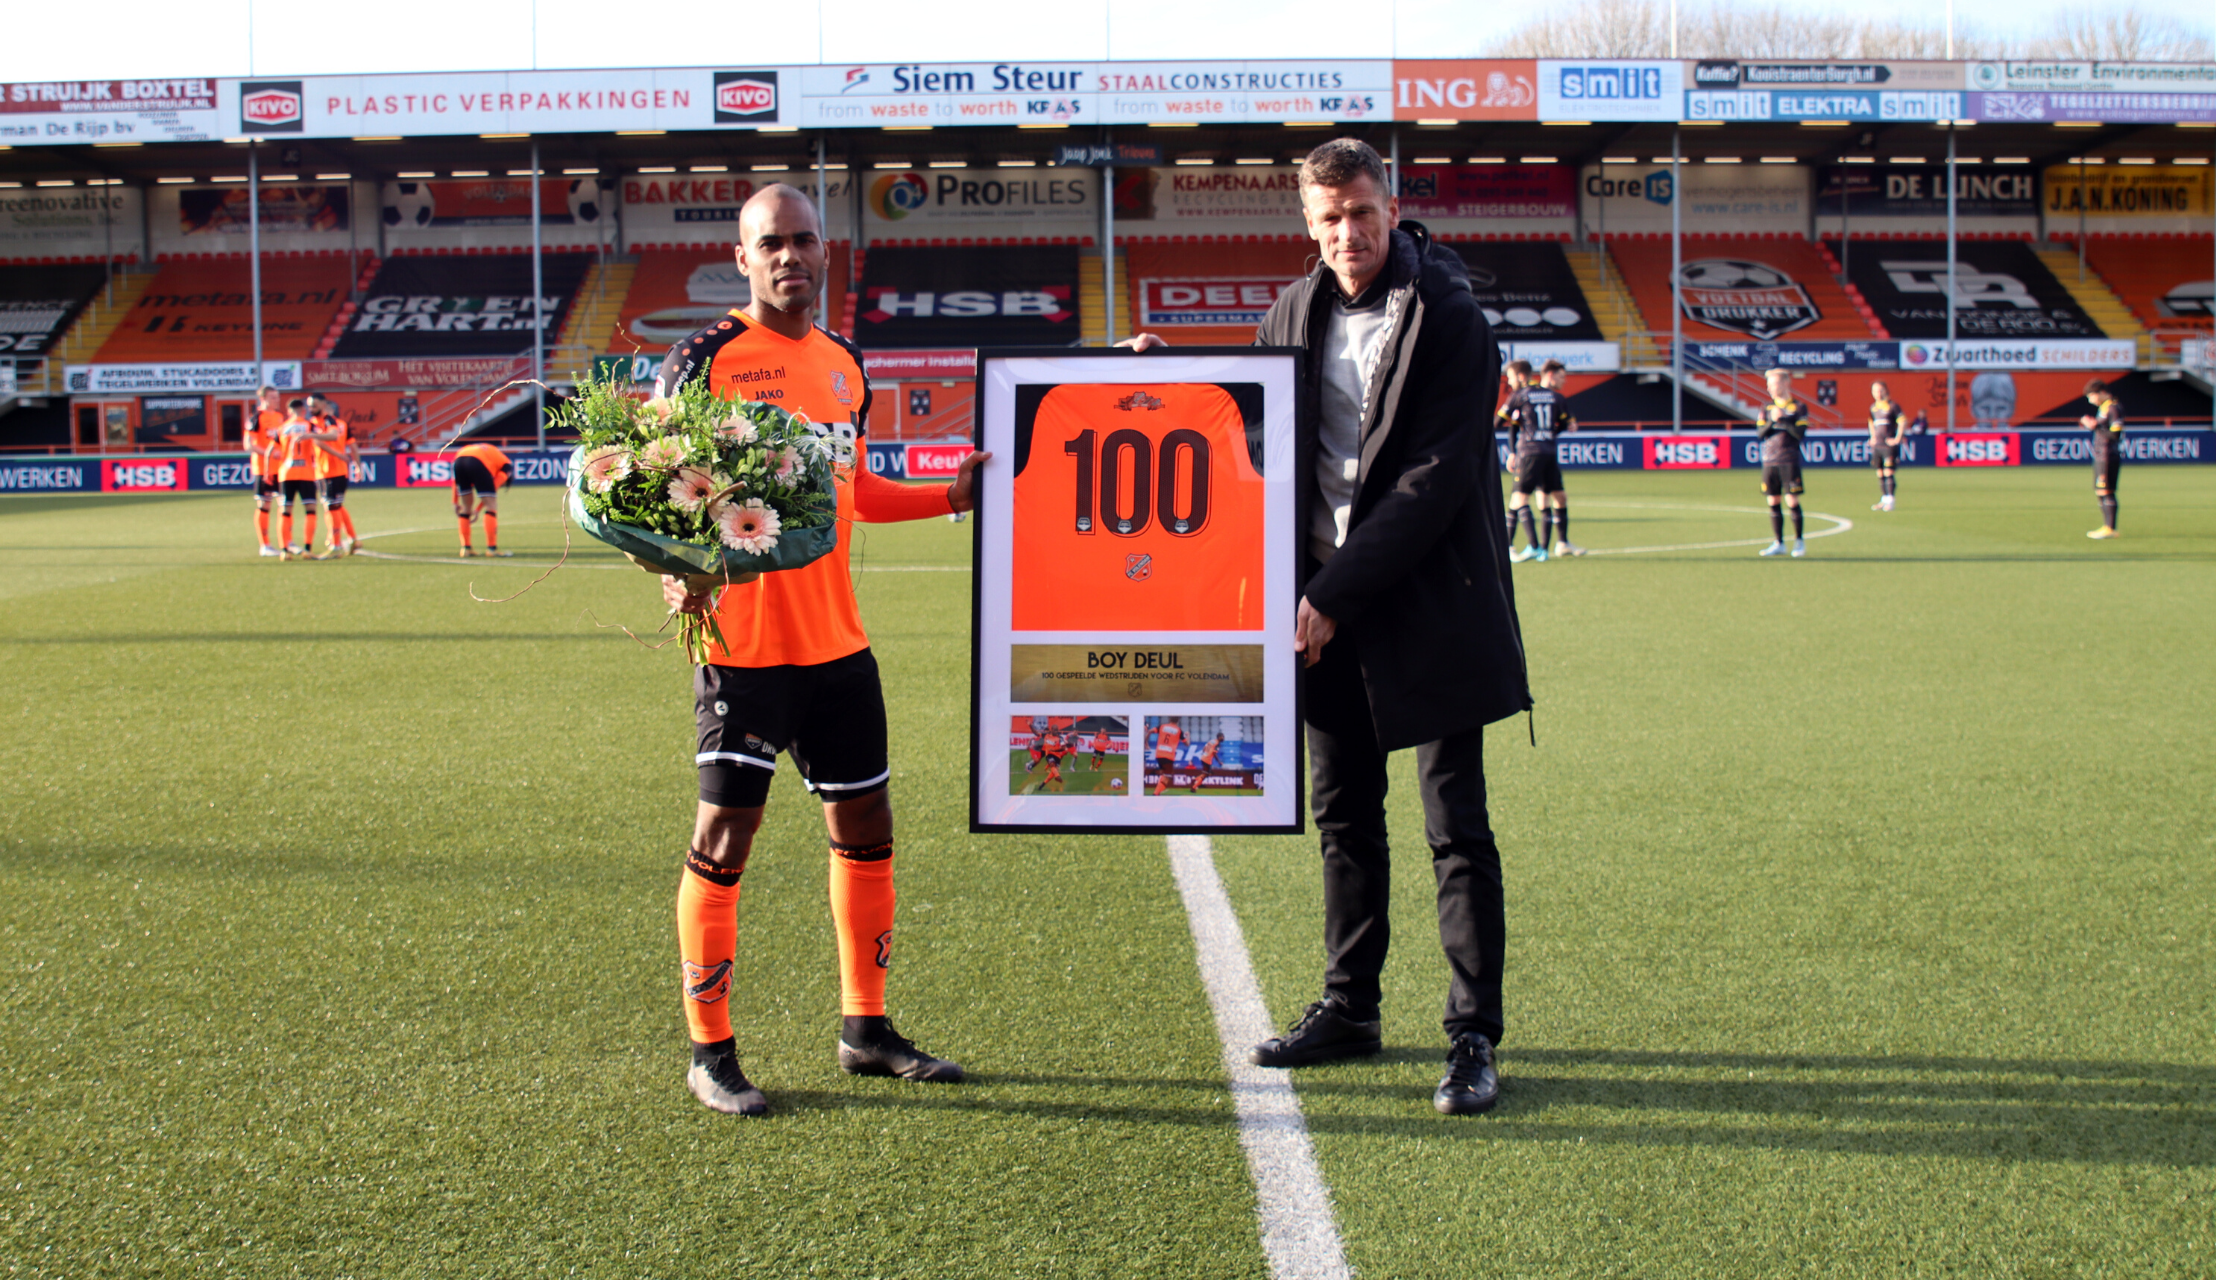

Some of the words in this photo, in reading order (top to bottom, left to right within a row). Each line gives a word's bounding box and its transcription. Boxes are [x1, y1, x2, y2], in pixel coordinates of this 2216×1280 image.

[894, 66, 975, 93] Siem
[993, 65, 1083, 92] Steur
[1696, 66, 1740, 81] Koffie?
[2006, 61, 2080, 79] Leinster
[11, 82, 113, 102] STRUIJK
[121, 80, 215, 101] BOXTEL
[1098, 72, 1343, 91] STAALCONSTRUCTIES
[1562, 68, 1660, 98] smit
[722, 91, 770, 106] KIVO
[1397, 78, 1478, 108] ING
[248, 101, 296, 116] KIVO
[328, 95, 449, 116] PLASTIC
[459, 90, 690, 112] VERPAKKINGEN
[819, 102, 864, 118] from
[870, 103, 929, 118] waste
[935, 102, 953, 116] to
[959, 100, 1018, 116] worth
[1114, 98, 1159, 115] from
[1165, 99, 1224, 114] waste
[1230, 98, 1249, 113] to
[1254, 97, 1314, 113] worth
[1691, 93, 1770, 119] smit
[1778, 97, 1873, 115] ELEKTRA
[1883, 94, 1957, 118] smit
[46, 122, 70, 136] De
[75, 121, 109, 137] Rijp
[114, 120, 136, 133] bv
[1116, 144, 1157, 160] Tribune
[463, 184, 531, 200] VOLENDA
[625, 180, 753, 204] BAKKER
[1173, 174, 1300, 191] KEMPENAARS
[1398, 172, 1438, 198] kel
[1587, 174, 1642, 198] Care
[1886, 174, 1924, 199] DE
[1932, 174, 2033, 199] LUNCH
[1457, 203, 1568, 217] STEIGERBOUW
[139, 288, 338, 308] metaa.nl
[878, 290, 1061, 317] HSB
[1694, 287, 1793, 306] VOETBAL
[1701, 306, 1801, 320] DRUKKER
[1699, 344, 1749, 357] SCHENK
[1778, 351, 1846, 365] RECYCLING
[2041, 349, 2130, 363] SCHILDERS
[928, 354, 977, 367] installa
[407, 374, 434, 385] VAN
[731, 365, 787, 385] metafa.nl
[755, 389, 784, 400] JAKO
[1534, 404, 1552, 429] 11
[1557, 443, 1623, 465] ERKEN
[1656, 442, 1718, 463] HSB
[1948, 440, 2007, 460] HSB
[2033, 437, 2096, 460] GEZON
[0, 465, 83, 488] WERKEN
[114, 465, 176, 487] HSB
[203, 463, 254, 486] GEZO
[408, 462, 456, 481] HS
[1064, 428, 1213, 539] 100
[1087, 652, 1128, 669] BOY
[1134, 652, 1184, 669] DEUL
[1056, 672, 1097, 680] GESPEELDE
[1098, 672, 1149, 680] WEDSTRIJDEN
